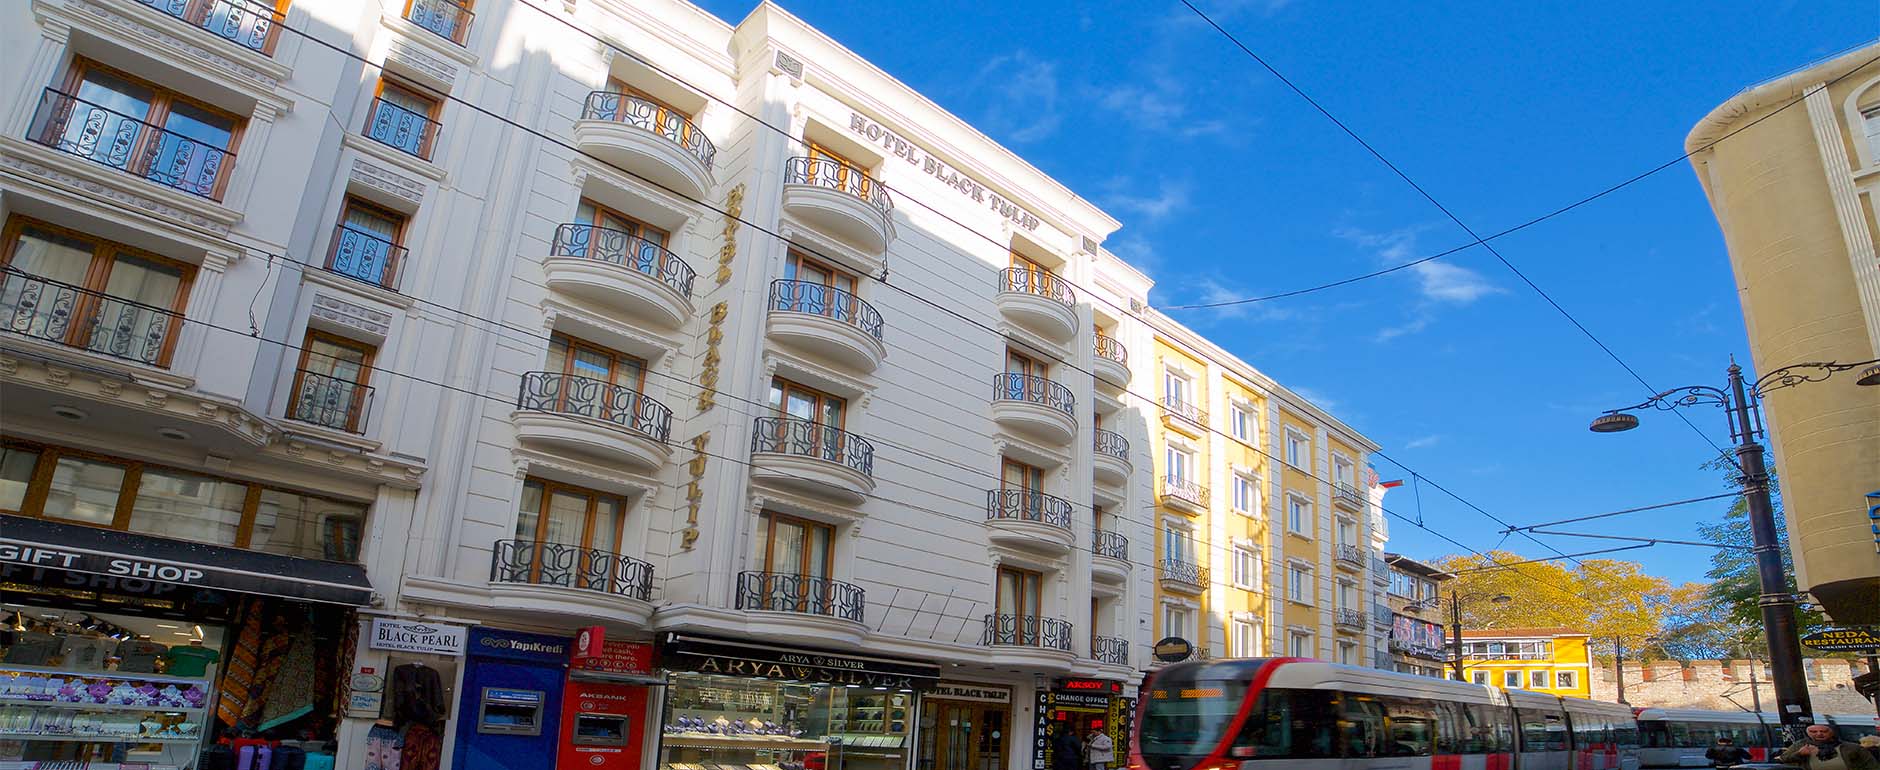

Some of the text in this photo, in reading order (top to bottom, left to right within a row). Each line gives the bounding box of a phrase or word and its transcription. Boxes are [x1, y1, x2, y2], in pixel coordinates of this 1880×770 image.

[848, 113, 1041, 232] HOTEL BLACK TULIP
[679, 181, 745, 549] HOTEL BLACK TULIP
[0, 544, 204, 583] GIFT SHOP
[379, 622, 402, 630] HOTEL
[378, 628, 459, 648] BLACK PEARL
[1823, 631, 1871, 639] NEDA
[509, 639, 564, 655] YapıKredi
[779, 654, 810, 665] ARYA
[698, 656, 786, 679] ARYA
[1065, 680, 1104, 690] AKSOY
[579, 692, 627, 702] AKBANK
[953, 687, 982, 698] BLACK
[982, 690, 1008, 700] TULIP
[1056, 693, 1109, 704] CHANGE OFFICE
[1037, 693, 1047, 759] CHANGE
